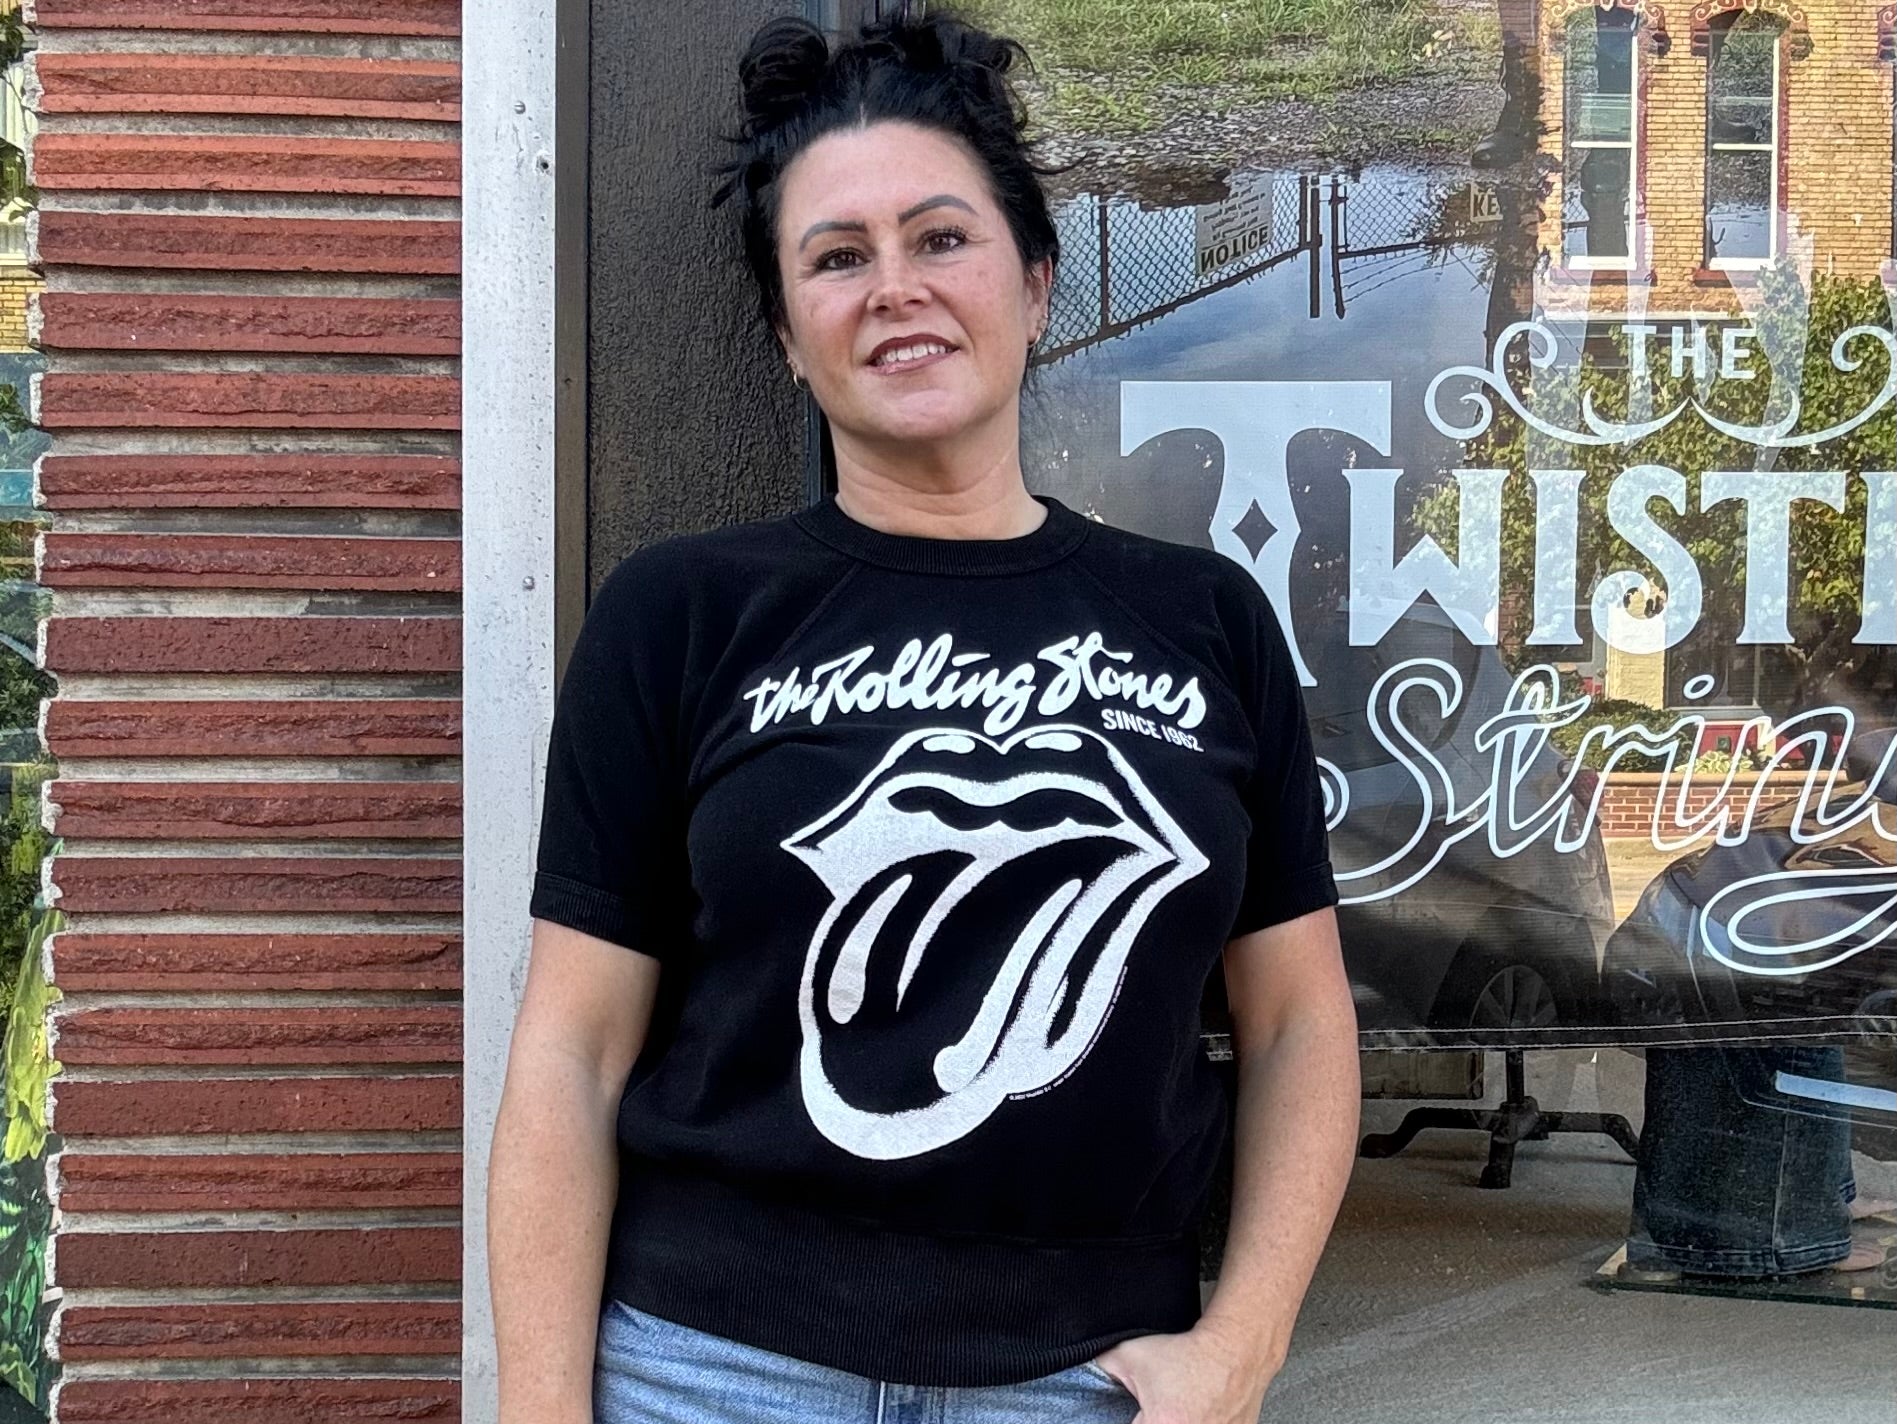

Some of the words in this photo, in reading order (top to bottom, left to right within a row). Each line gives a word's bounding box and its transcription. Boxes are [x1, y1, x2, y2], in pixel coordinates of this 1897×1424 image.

[1621, 324, 1757, 380] THE
[810, 633, 1036, 735] Rolling
[1037, 631, 1207, 729] Stones
[1101, 708, 1162, 740] SINCE
[1161, 724, 1204, 753] 1962
